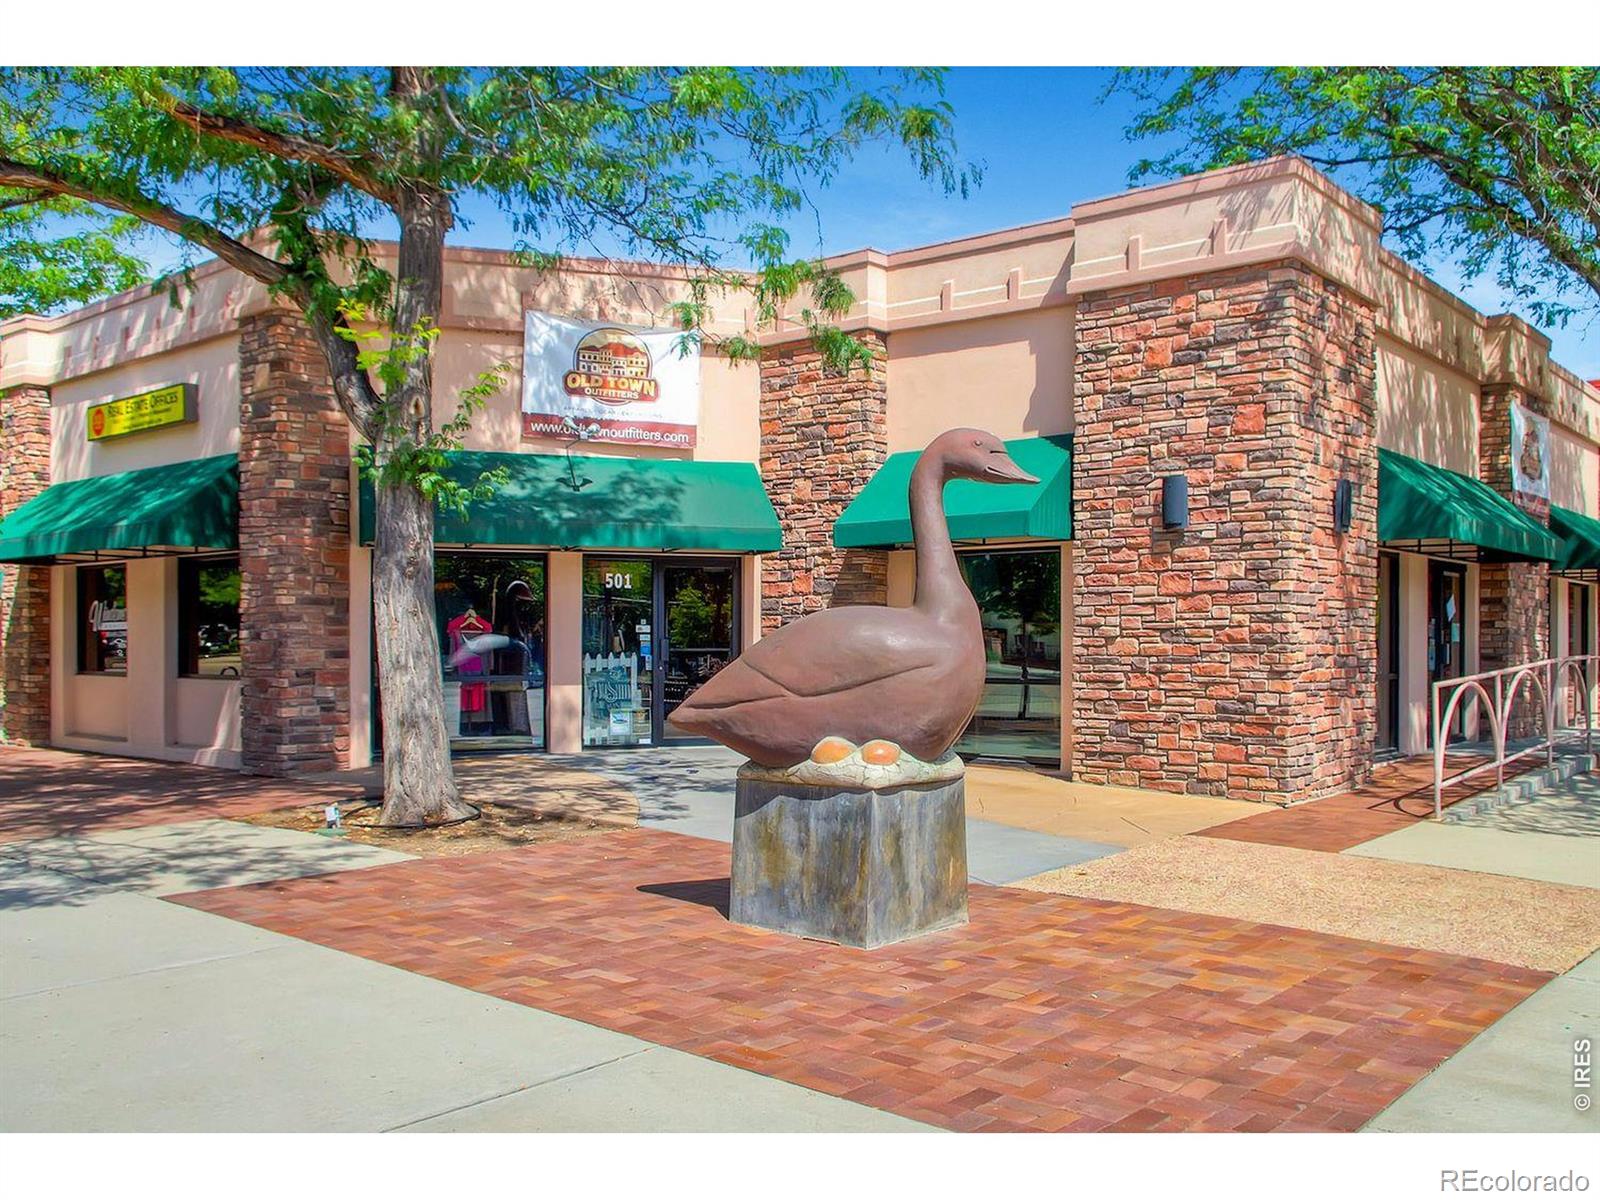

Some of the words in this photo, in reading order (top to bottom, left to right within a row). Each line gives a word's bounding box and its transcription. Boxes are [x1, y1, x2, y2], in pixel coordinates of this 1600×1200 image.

[567, 372, 603, 389] OLD
[606, 376, 656, 396] TOWN
[584, 387, 639, 399] OUTFITTERS
[605, 572, 632, 589] 501
